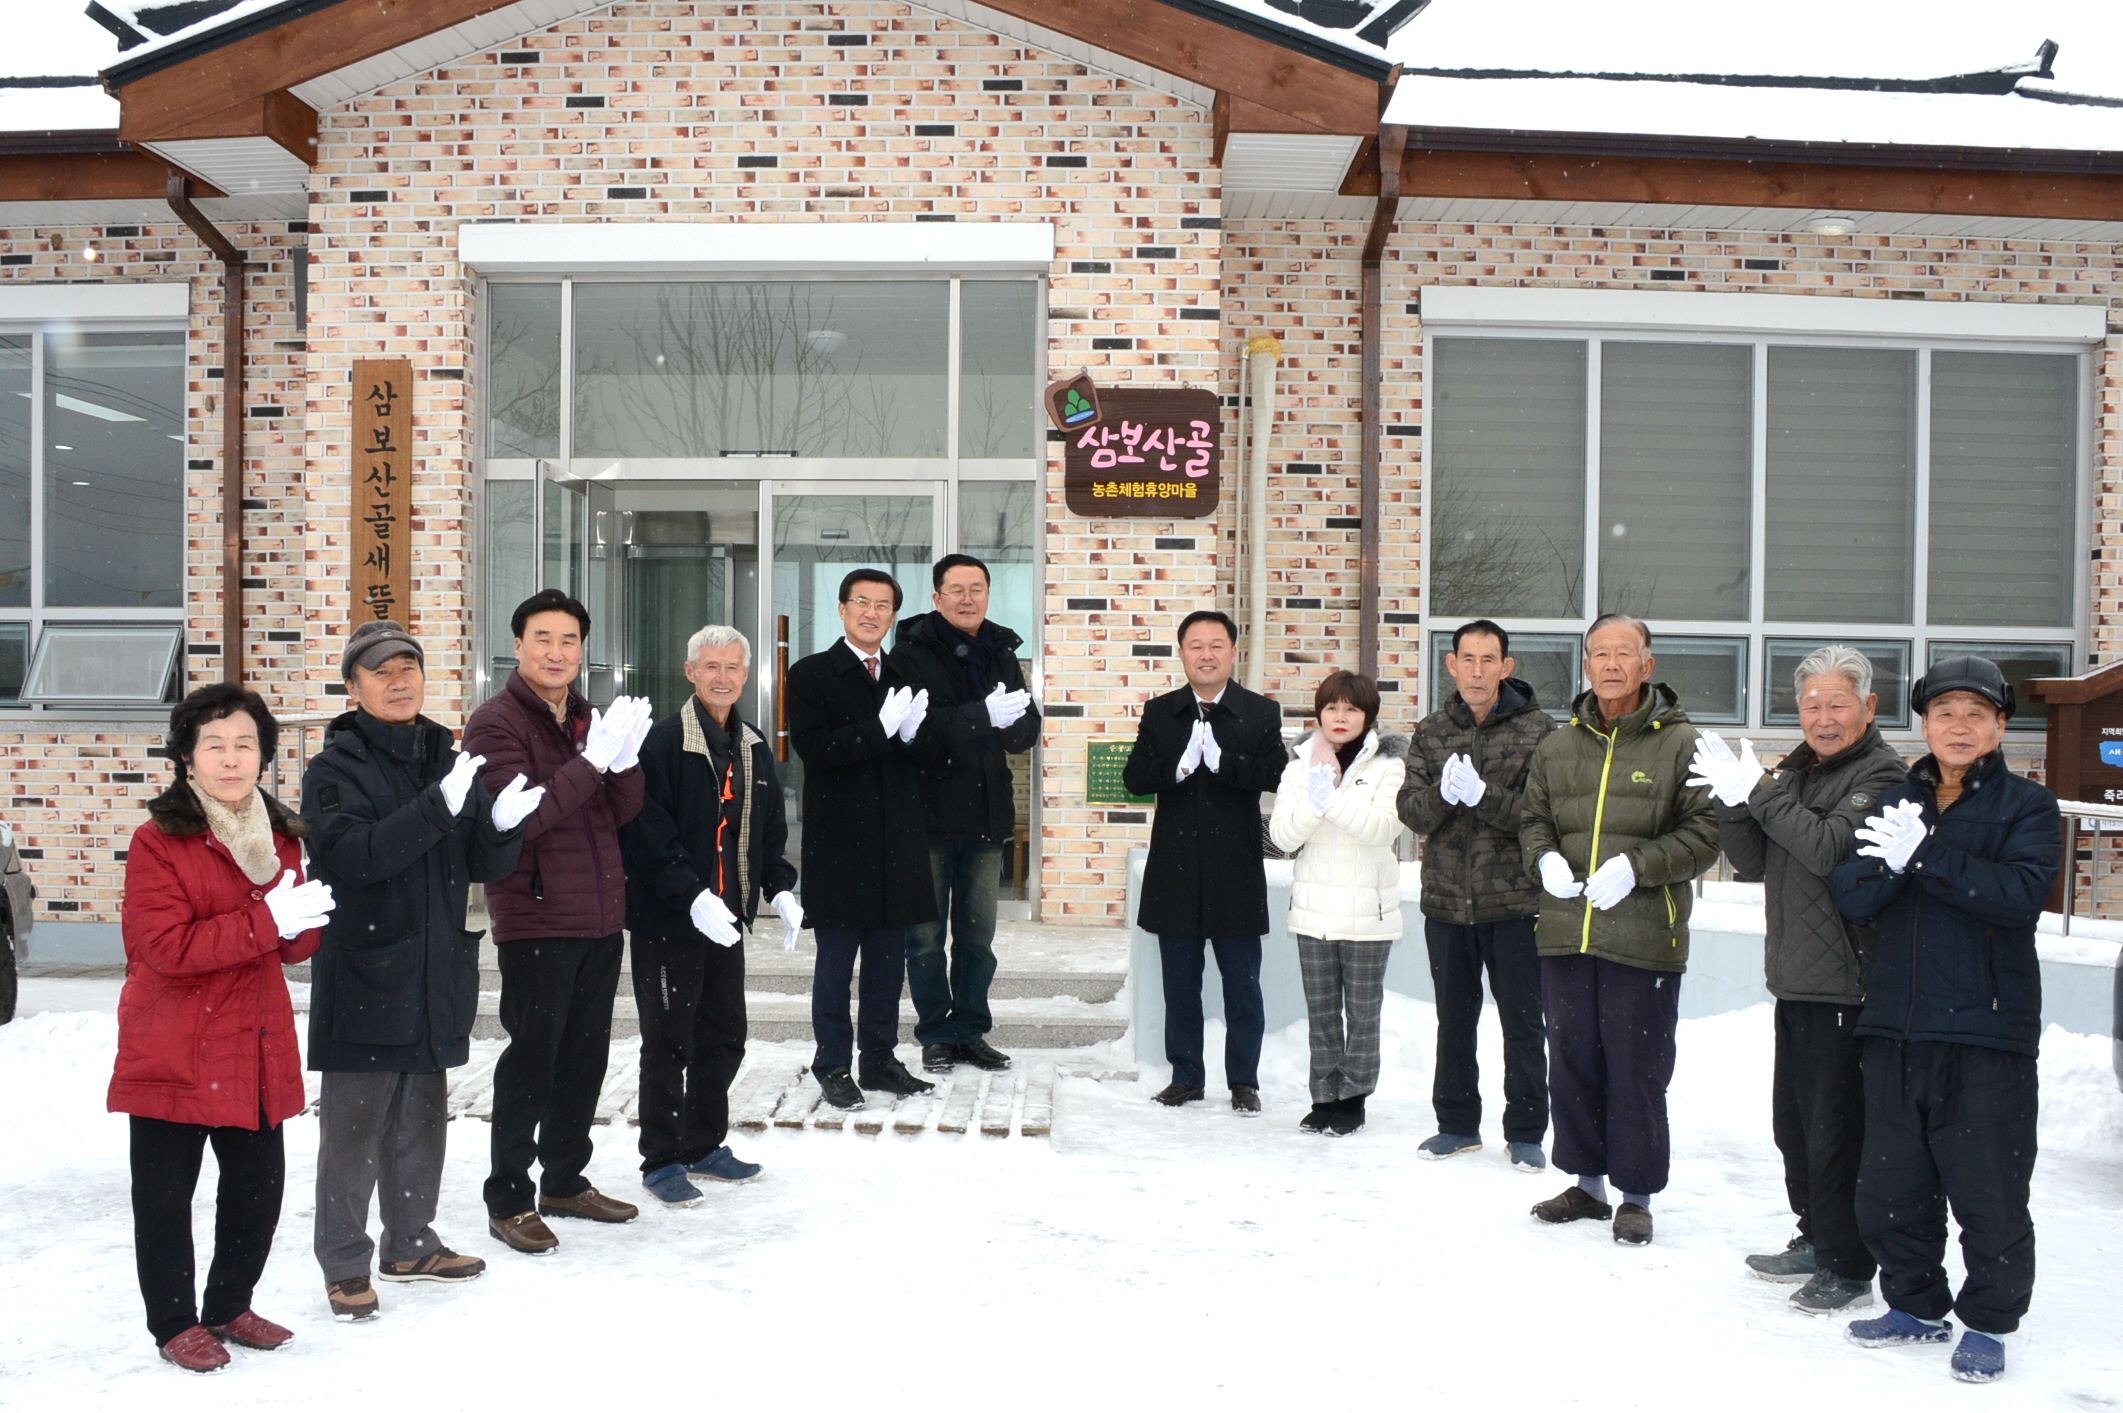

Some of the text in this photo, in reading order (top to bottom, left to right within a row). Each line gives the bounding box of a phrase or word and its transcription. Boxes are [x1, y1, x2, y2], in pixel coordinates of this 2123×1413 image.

[1077, 420, 1214, 478] 삼보산골
[1092, 482, 1198, 498] 농촌체험휴양마을
[2101, 727, 2123, 736] 지역희
